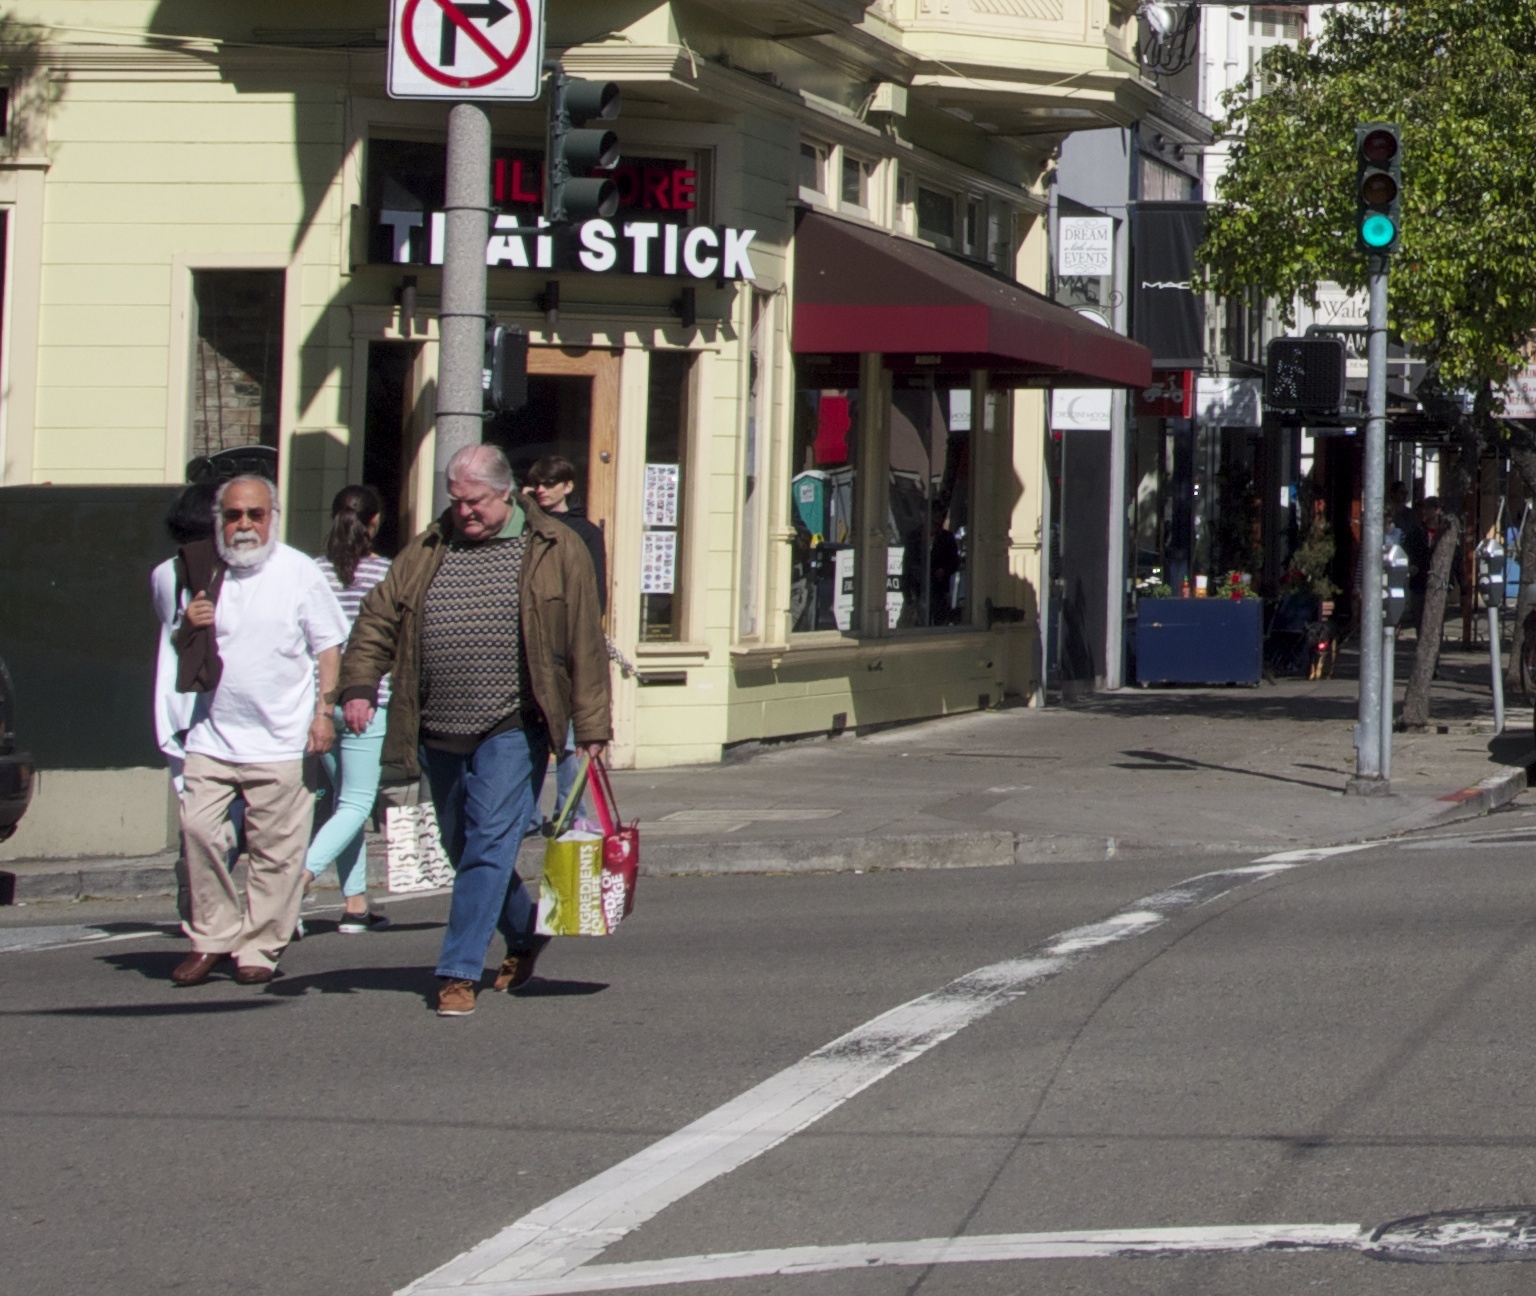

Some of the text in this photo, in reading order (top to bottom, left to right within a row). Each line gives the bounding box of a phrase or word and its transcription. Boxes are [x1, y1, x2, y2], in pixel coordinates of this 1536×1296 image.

[1065, 228, 1108, 241] DREAM
[579, 218, 757, 280] STICK
[1064, 252, 1108, 264] EVENTS
